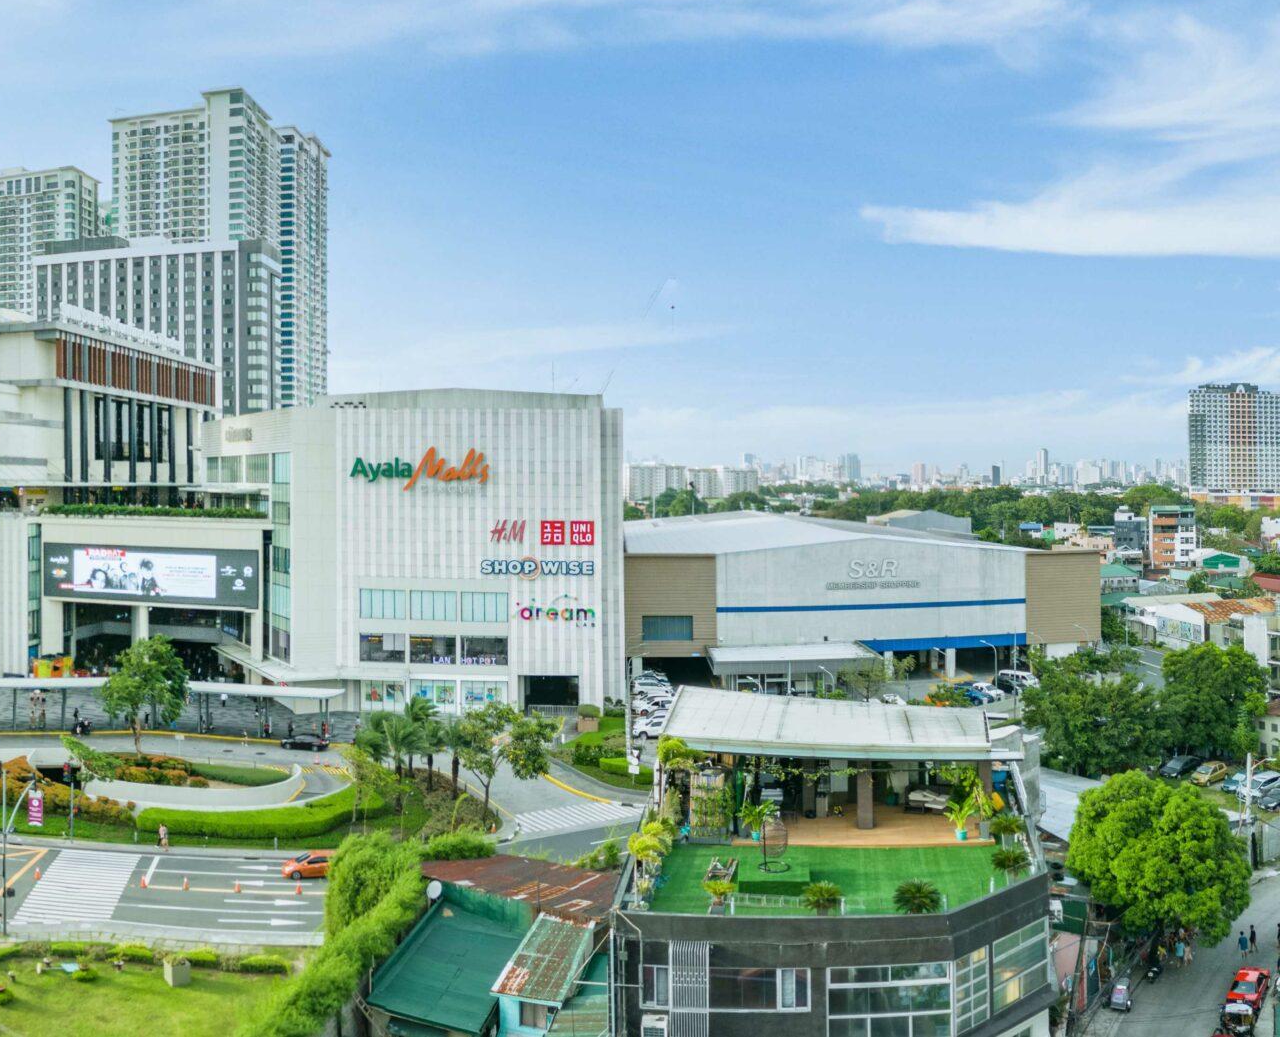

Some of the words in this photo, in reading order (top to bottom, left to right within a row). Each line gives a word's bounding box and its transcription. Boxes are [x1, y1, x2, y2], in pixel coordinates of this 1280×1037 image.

[350, 457, 413, 483] Ayala
[402, 446, 490, 492] Malls
[490, 519, 527, 544] H&M
[573, 523, 591, 532] UNI
[573, 533, 592, 543] QLO
[848, 558, 898, 579] S&R
[825, 581, 877, 590] MEMBERSHIP
[879, 580, 921, 589] SHOPPING
[520, 605, 596, 621] dream
[462, 657, 478, 665] HOT
[479, 657, 497, 665] POT
